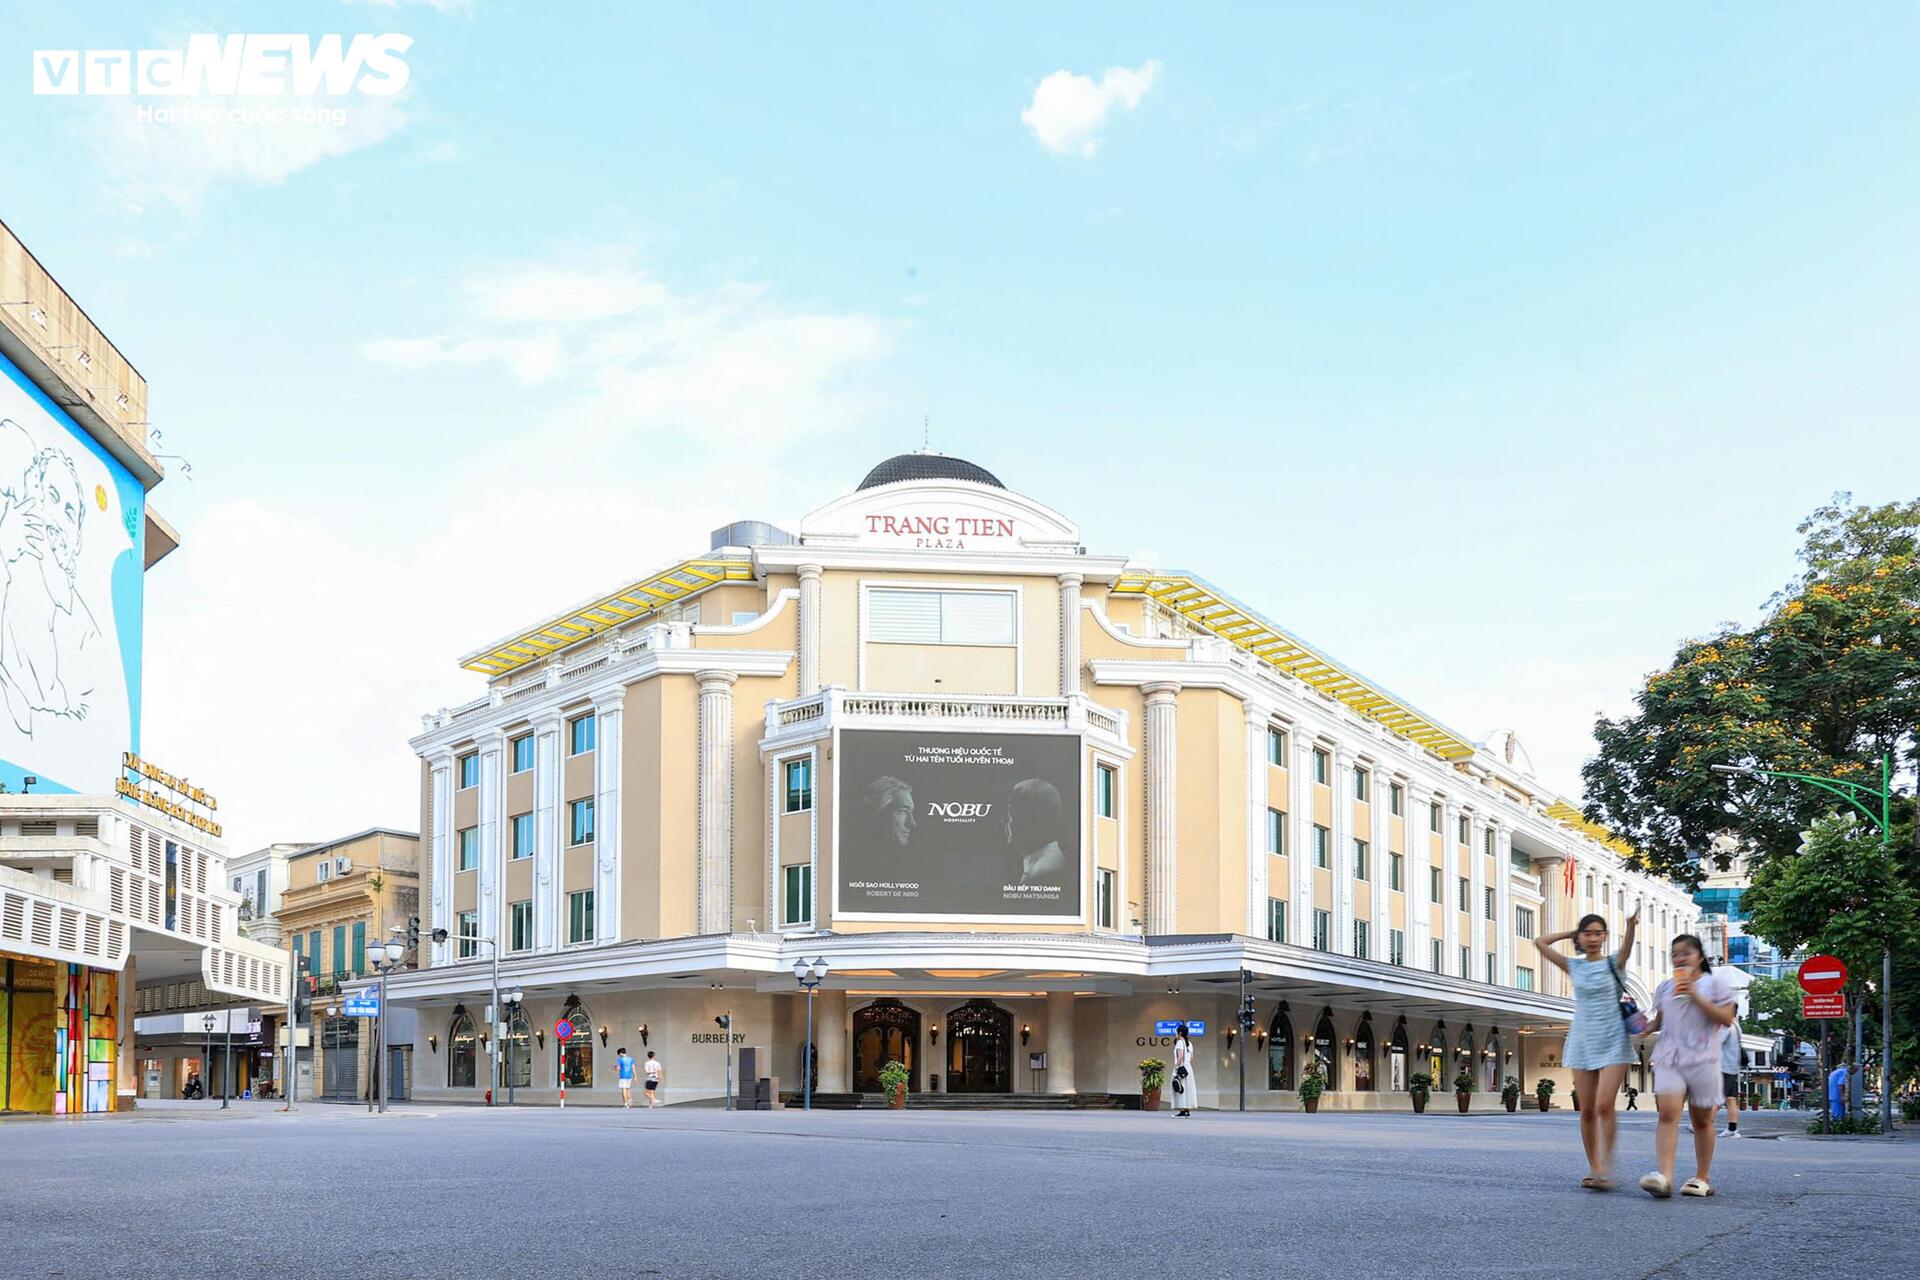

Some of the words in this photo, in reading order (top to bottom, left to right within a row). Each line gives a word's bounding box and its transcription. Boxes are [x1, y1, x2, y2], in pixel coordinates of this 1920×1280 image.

[865, 514, 950, 537] TRANG
[955, 517, 1015, 537] TIEN
[916, 538, 965, 550] PLAZA
[970, 746, 991, 756] QUỐC
[916, 755, 929, 763] HAI
[928, 802, 992, 817] NOBU
[1136, 1037, 1177, 1047] GUC
